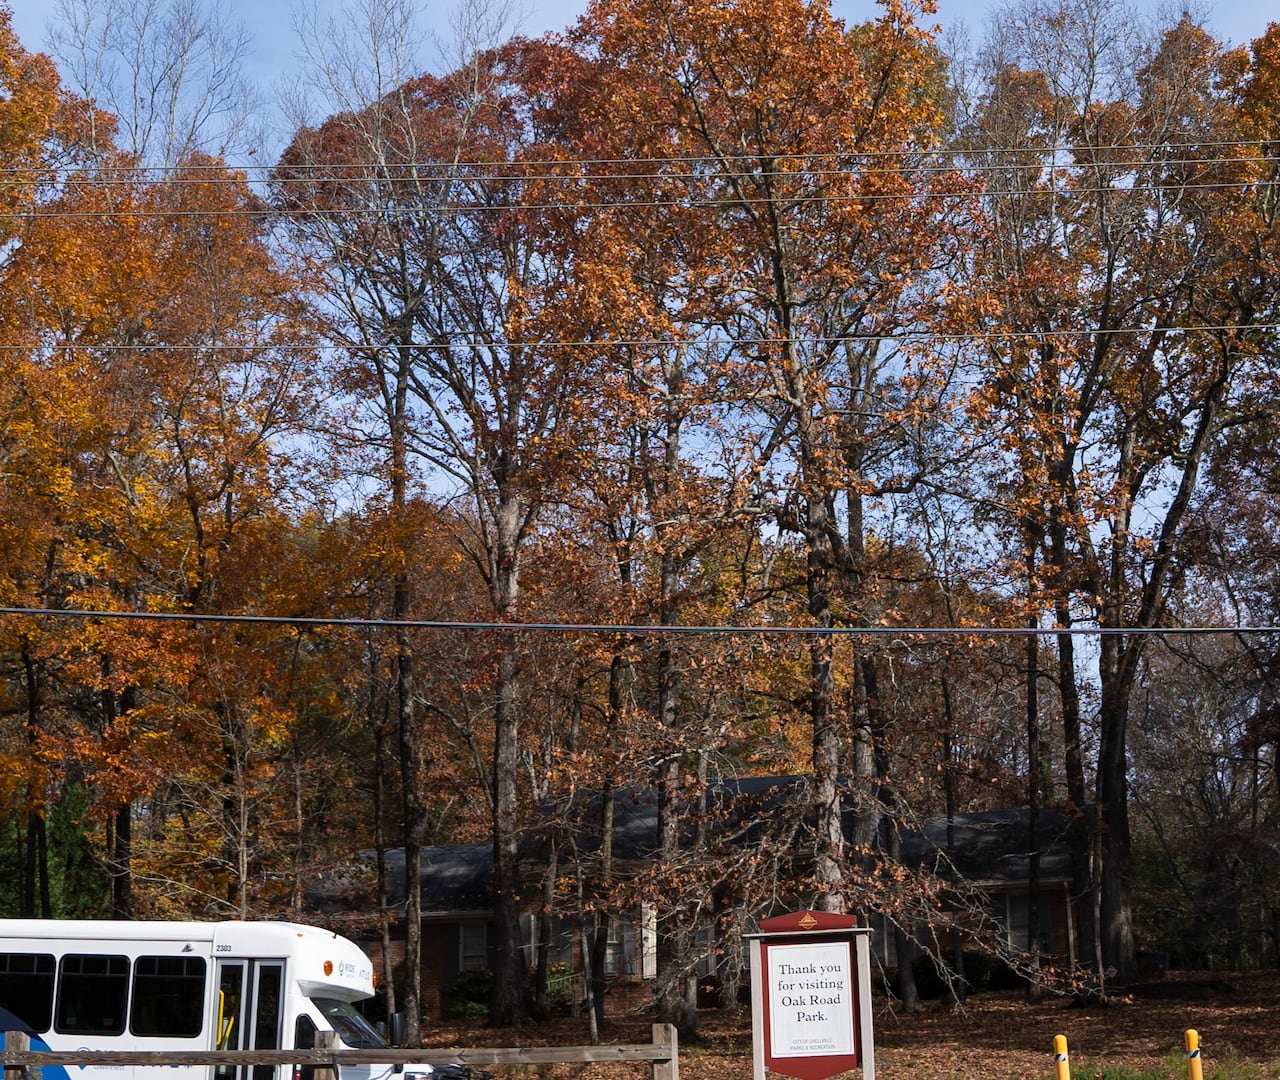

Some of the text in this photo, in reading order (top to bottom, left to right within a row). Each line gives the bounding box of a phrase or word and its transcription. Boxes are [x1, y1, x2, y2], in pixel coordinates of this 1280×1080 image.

[778, 963, 841, 975] Thank you
[778, 978, 843, 990] for visiting
[781, 994, 840, 1006] Oak Road
[797, 1011, 828, 1022] Park.
